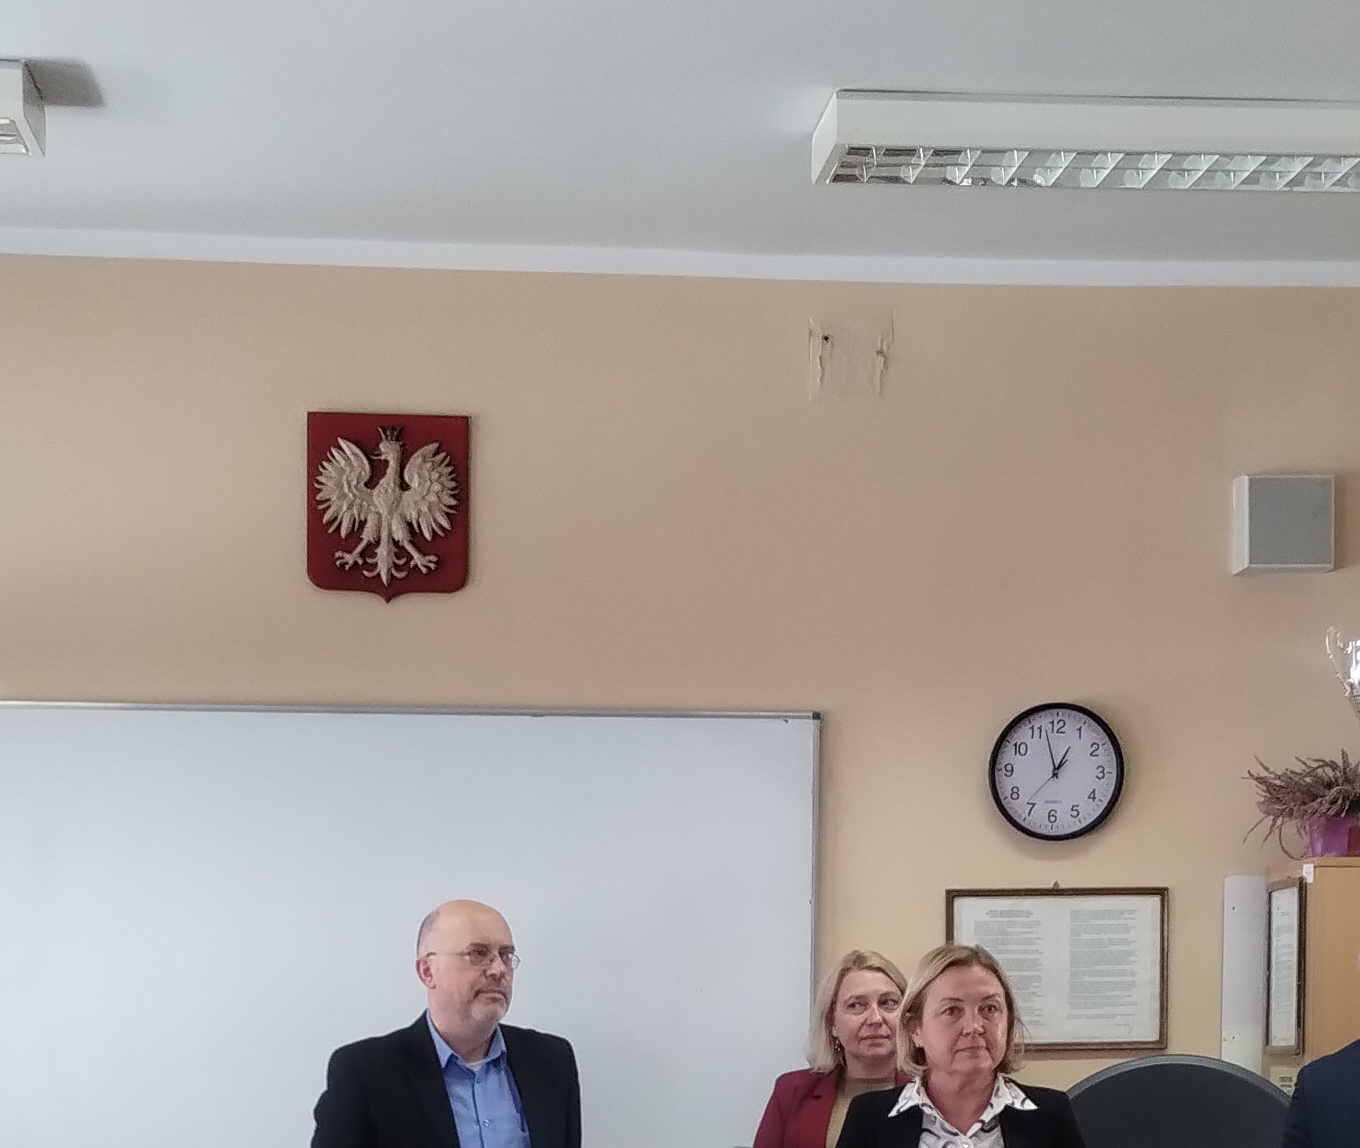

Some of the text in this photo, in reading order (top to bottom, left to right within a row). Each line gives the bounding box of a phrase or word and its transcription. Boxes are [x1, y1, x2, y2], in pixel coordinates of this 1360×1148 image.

[1028, 725, 1043, 739] 11
[1049, 719, 1066, 735] 12
[1076, 726, 1083, 740] 1
[1012, 741, 1029, 757] 10
[1089, 742, 1100, 757] 2
[1003, 763, 1015, 778] 9
[1095, 765, 1106, 780] 3
[1009, 786, 1020, 801] 8
[1087, 788, 1097, 802] 4
[1027, 802, 1037, 817] 7
[1047, 810, 1058, 824] 6
[1070, 804, 1080, 819] 5
